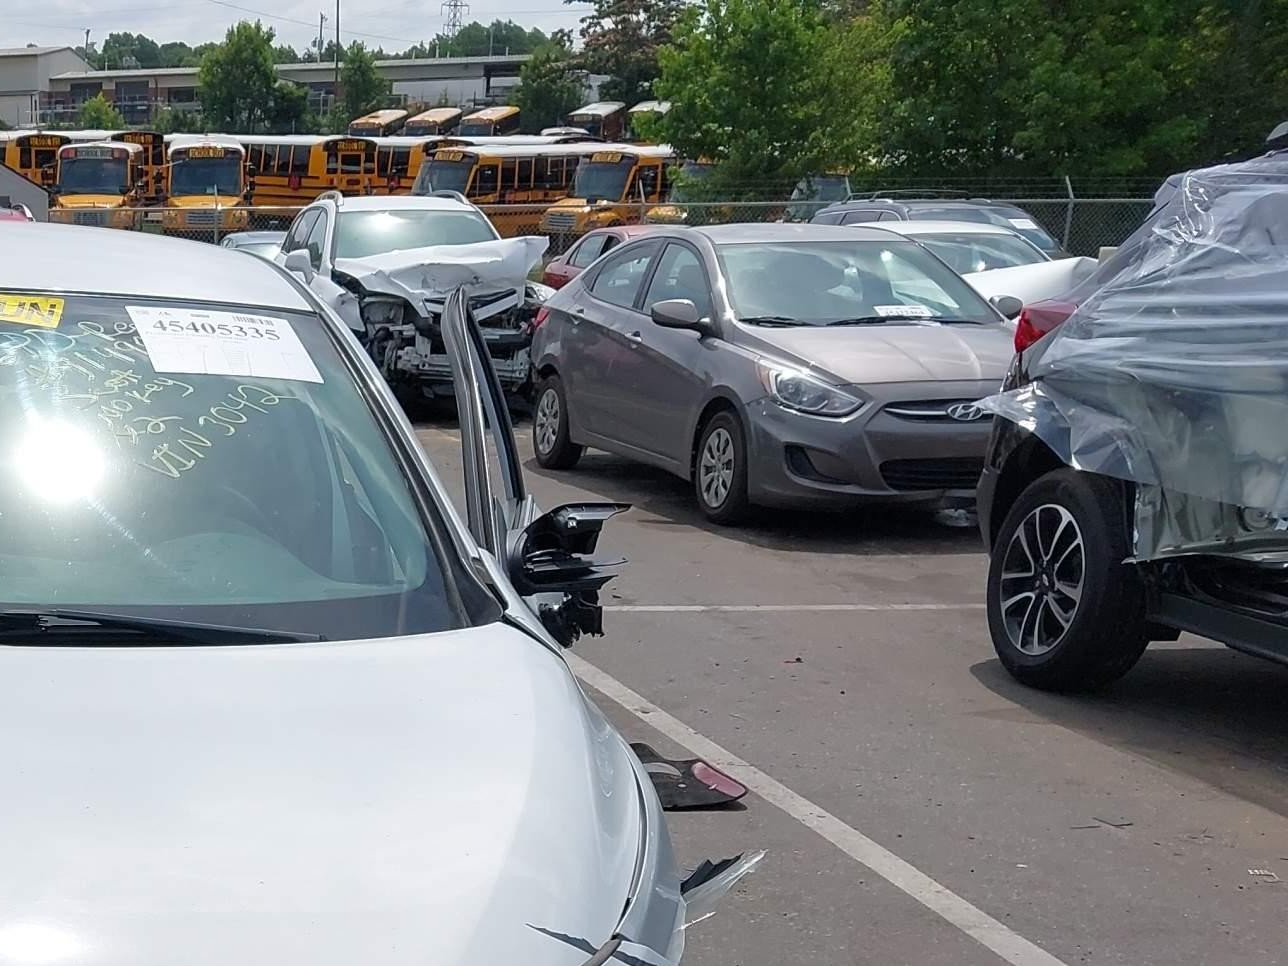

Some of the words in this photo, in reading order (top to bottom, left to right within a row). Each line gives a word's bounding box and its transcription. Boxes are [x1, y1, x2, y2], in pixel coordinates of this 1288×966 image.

[152, 319, 281, 342] 45405335
[134, 426, 213, 478] VIN
[198, 384, 287, 437] 3042
